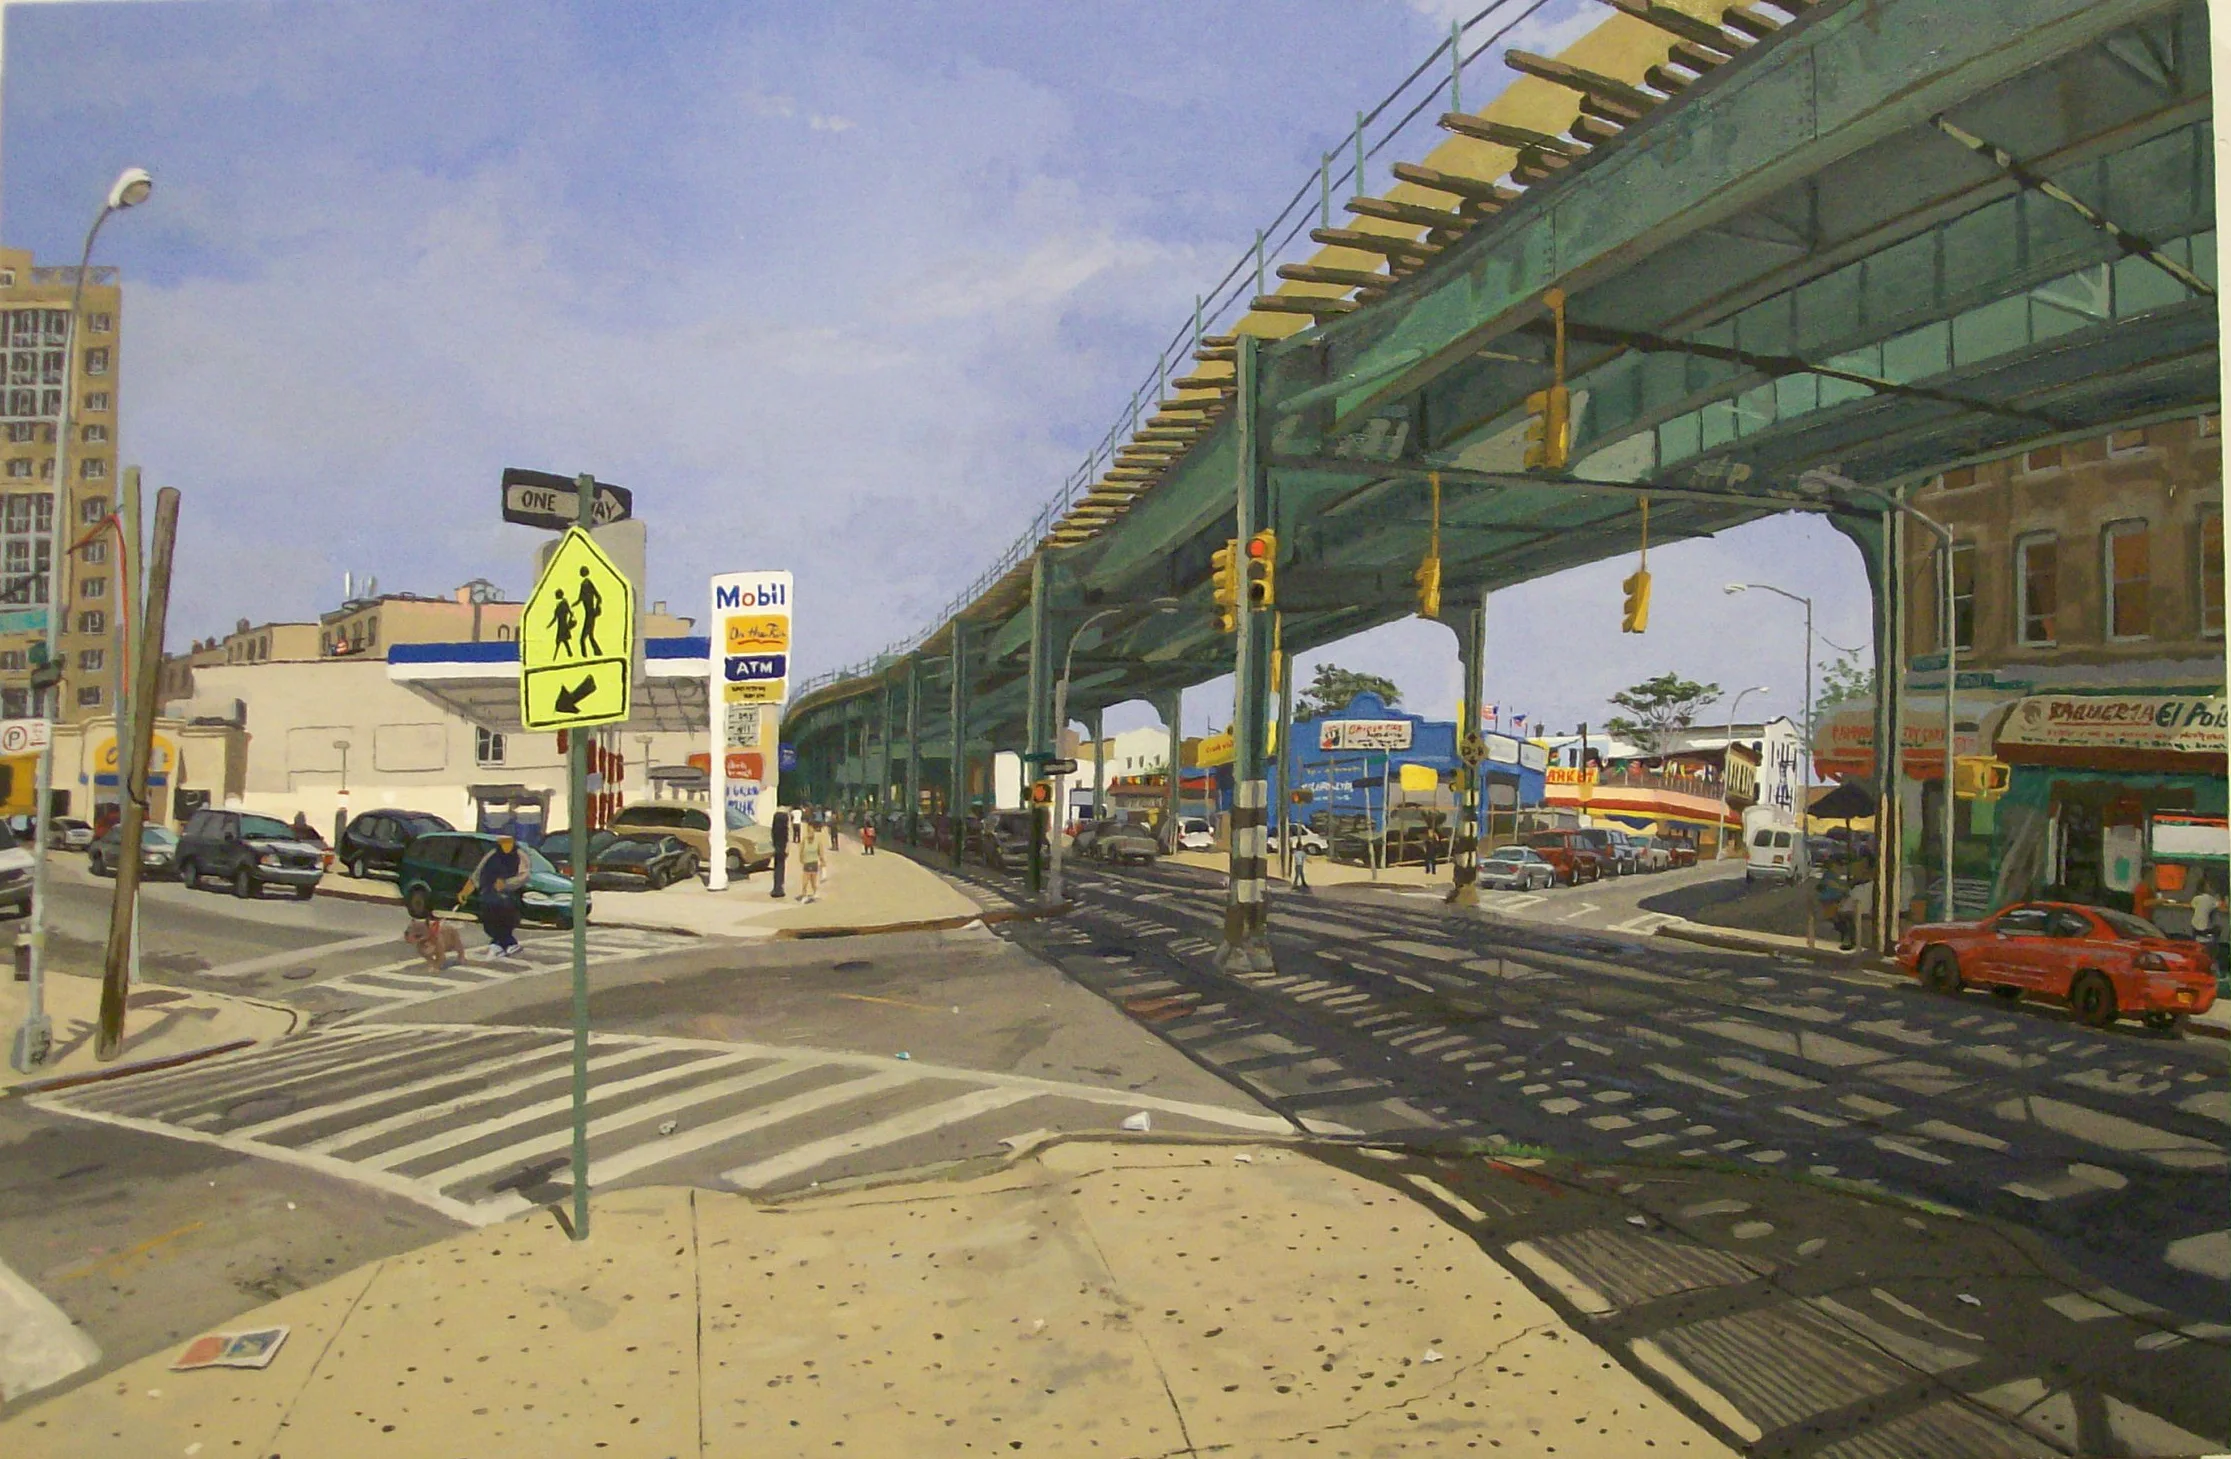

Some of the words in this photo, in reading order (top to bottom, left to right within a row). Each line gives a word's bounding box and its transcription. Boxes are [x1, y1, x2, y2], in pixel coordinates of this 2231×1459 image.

[521, 489, 557, 512] ONE
[591, 500, 617, 520] AY
[716, 582, 785, 610] Mobil
[736, 660, 773, 676] ATM
[2156, 701, 2184, 727] El
